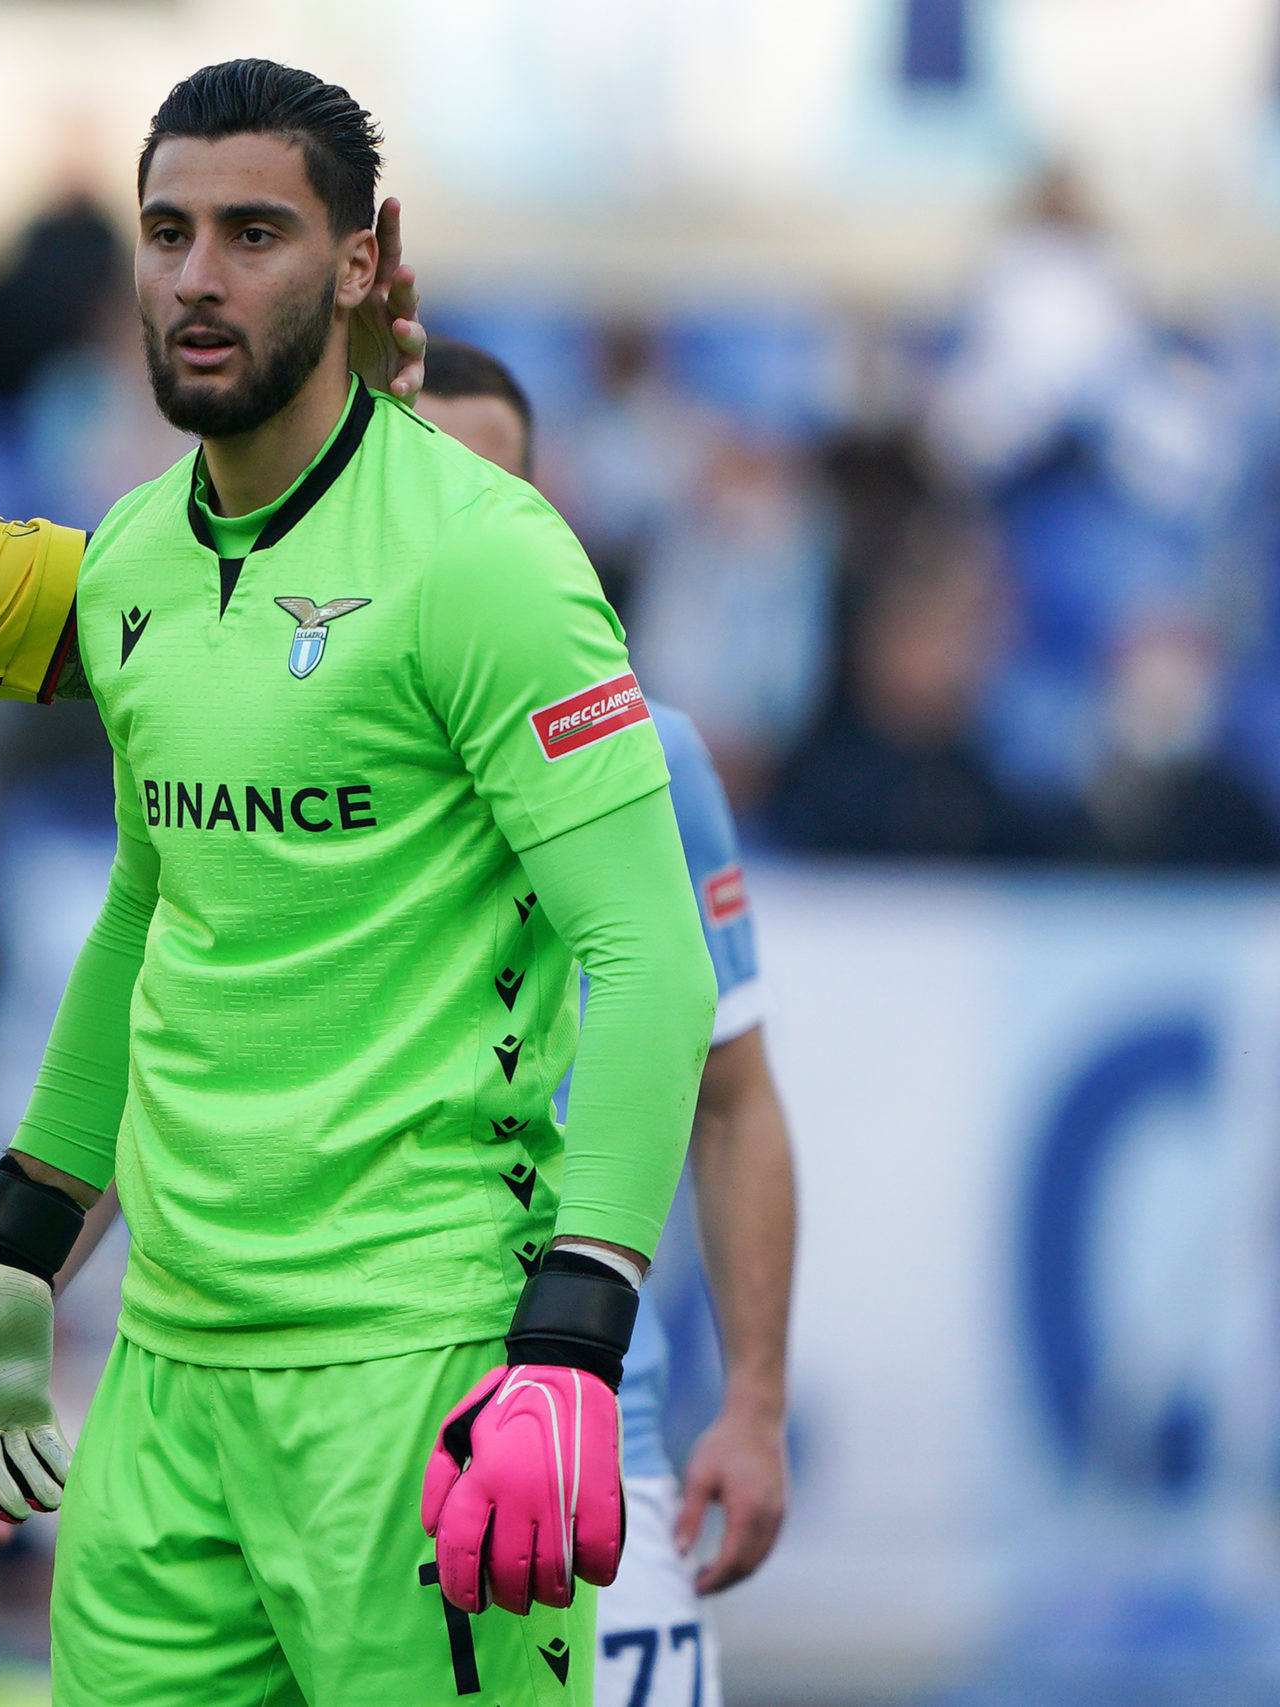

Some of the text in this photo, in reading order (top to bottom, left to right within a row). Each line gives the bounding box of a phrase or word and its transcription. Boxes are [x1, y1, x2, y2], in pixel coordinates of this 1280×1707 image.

[548, 687, 642, 737] FRECCIAROSS
[144, 779, 377, 833] BINANCE
[603, 1623, 701, 1707] 77
